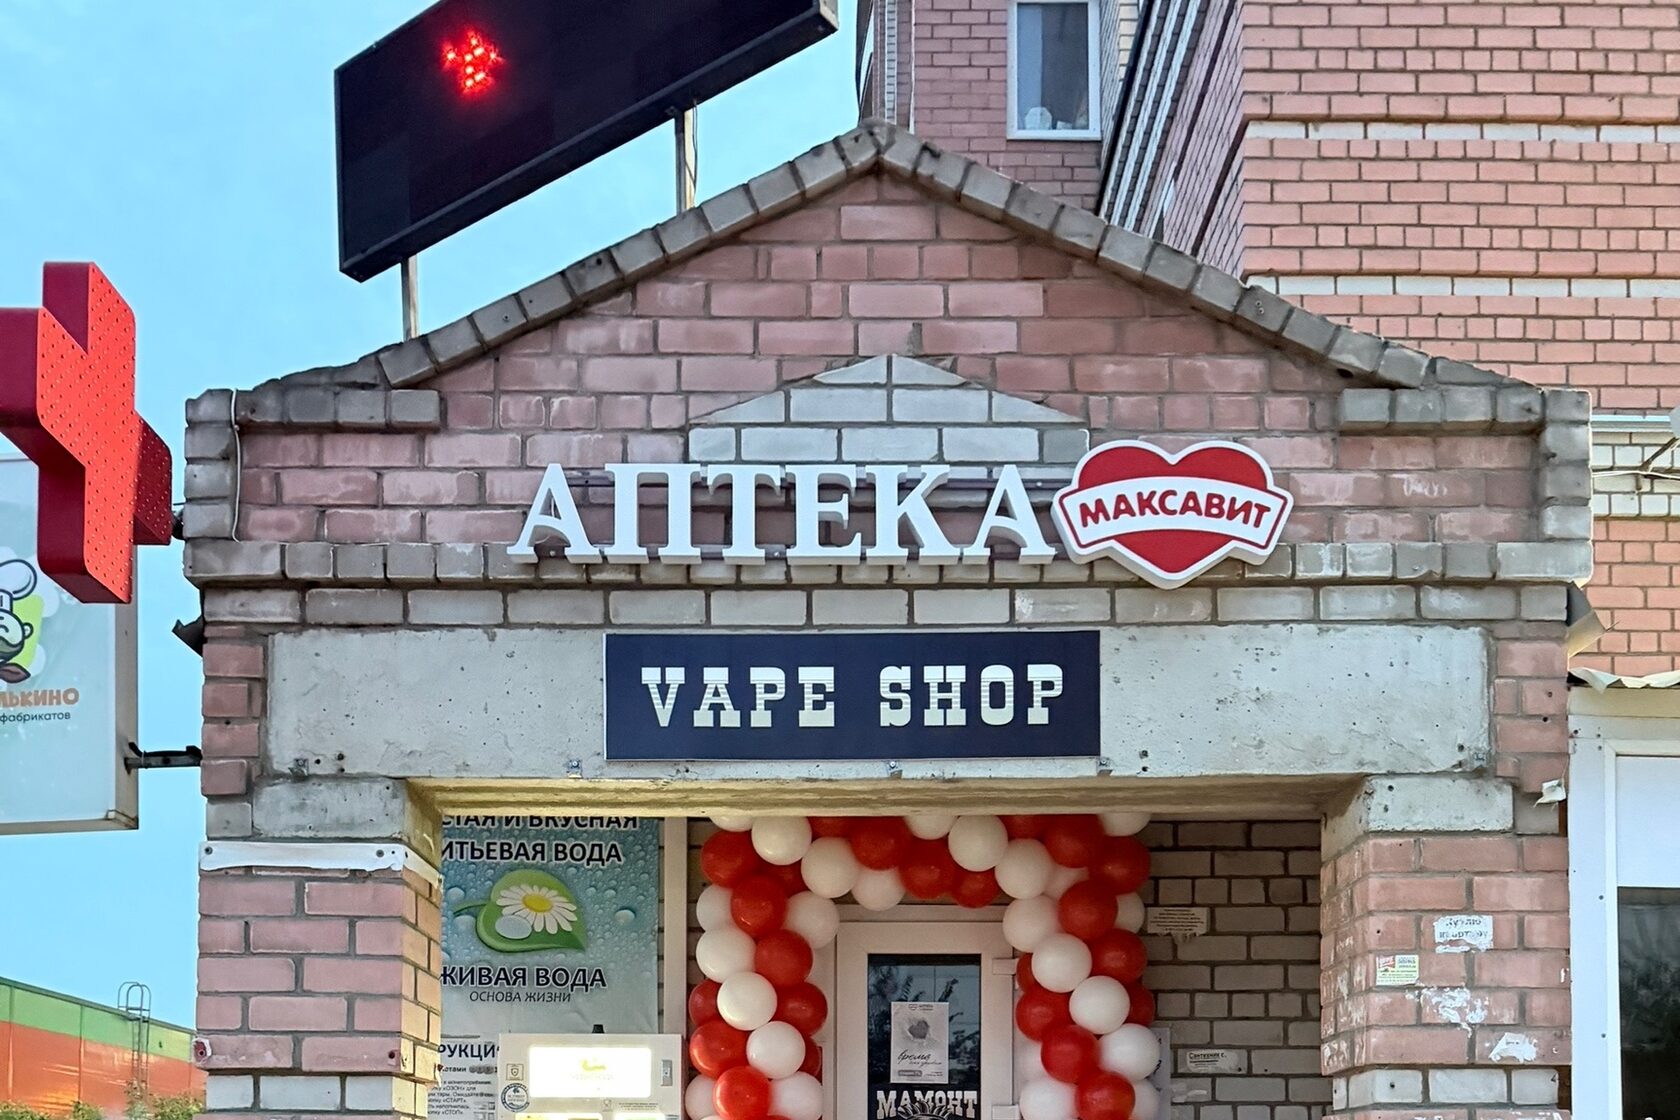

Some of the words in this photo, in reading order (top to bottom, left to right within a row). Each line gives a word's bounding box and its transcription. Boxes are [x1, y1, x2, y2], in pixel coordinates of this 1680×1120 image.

[505, 462, 1057, 567] АПТЕКА
[1079, 488, 1272, 530] МАКСАВИТ
[641, 666, 836, 728] VAPE
[878, 664, 1064, 727] SHOP
[554, 842, 622, 866] ВОДА
[441, 966, 527, 986] ЖИВАЯ
[535, 967, 607, 992] ВОДА
[469, 990, 522, 1002] ОСНОВА
[524, 991, 571, 1003] ЖИЗНИ
